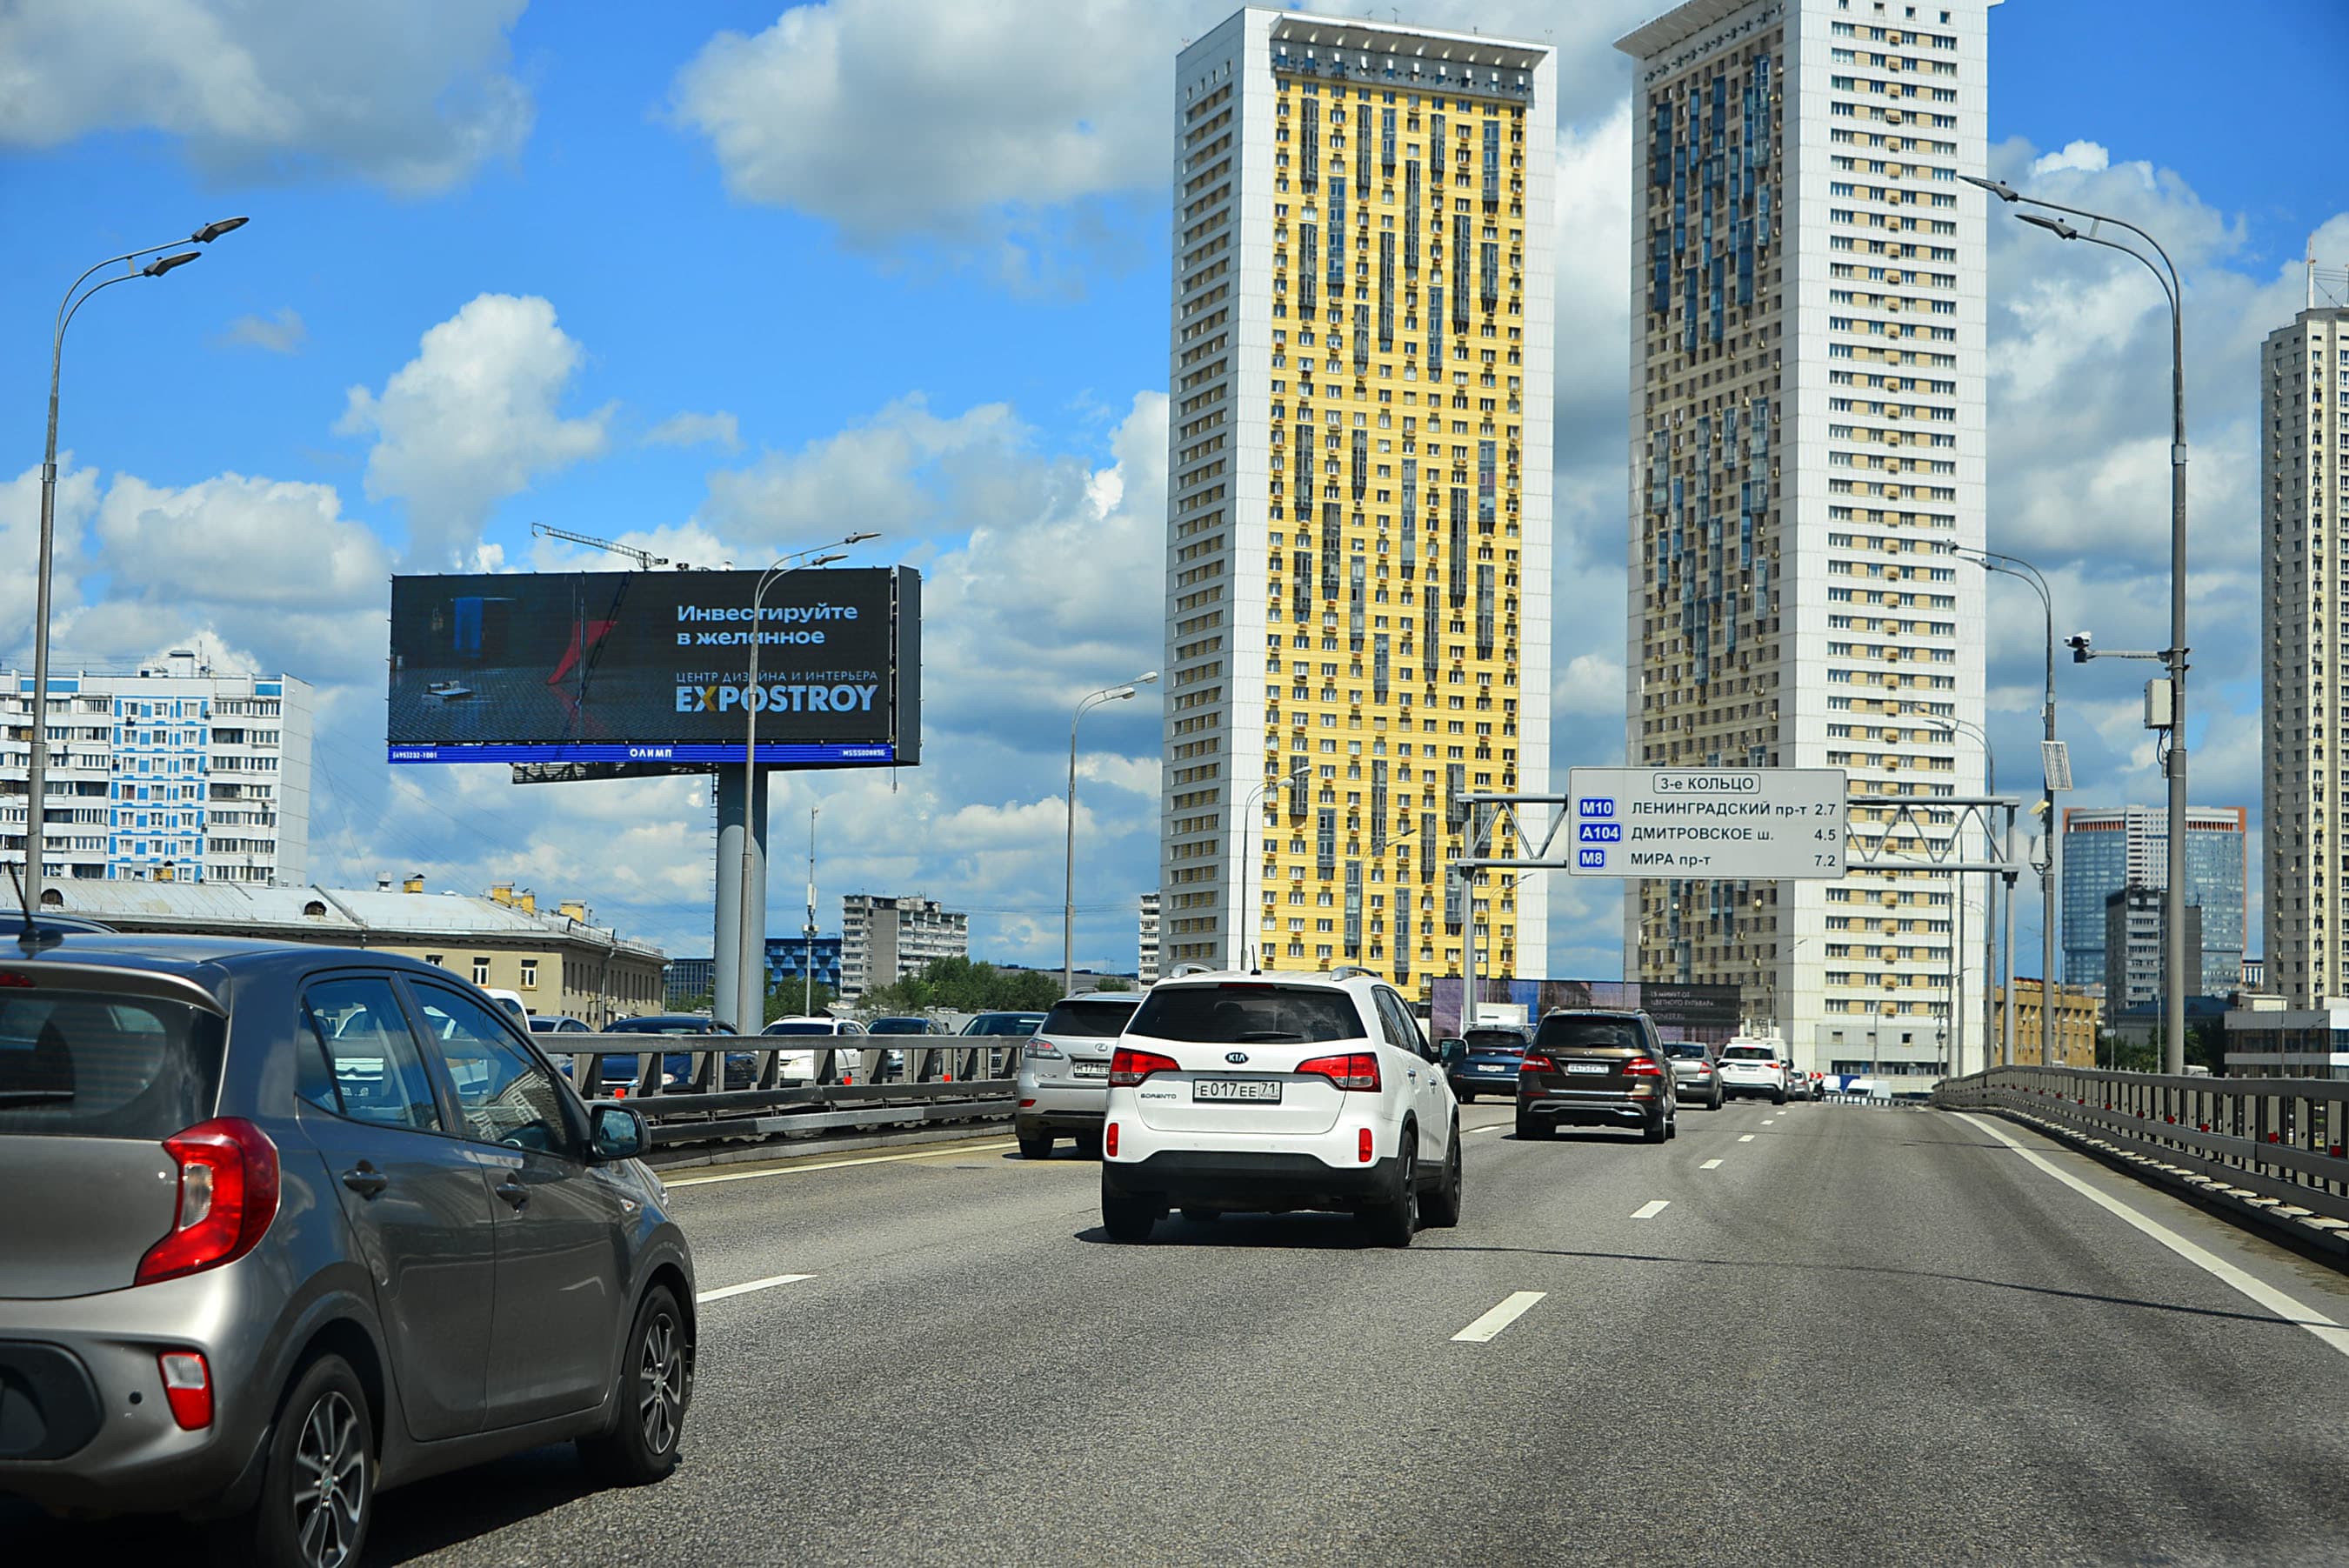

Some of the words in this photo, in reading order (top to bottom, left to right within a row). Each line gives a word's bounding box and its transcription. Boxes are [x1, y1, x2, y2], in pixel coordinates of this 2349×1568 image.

[677, 603, 858, 624] Инвестируйте
[677, 632, 691, 645] в
[696, 631, 825, 645] желанное
[676, 671, 718, 683] ЦЕНТР
[722, 670, 787, 682] ДИЗЙНА
[791, 671, 801, 682] И
[805, 671, 878, 682] ИНТЕРЬЕРА
[676, 684, 879, 712] EXPOSTROY
[629, 748, 672, 757] ОЛИМП
[1660, 777, 1683, 790] 3-е
[1687, 777, 1754, 792] КОЛЬЦО
[1582, 802, 1613, 814] М10
[1632, 800, 1771, 816] ЛЕНИНГРАДСКИЙ
[1775, 805, 1807, 817] пр-т
[1815, 804, 1836, 816] 2.7
[1581, 827, 1620, 839] А104
[1632, 827, 1752, 842] ДМИТРОВСКОЕ
[1757, 830, 1774, 841] ш.
[1814, 829, 1836, 841] 4.5
[1582, 853, 1604, 865] М8
[1631, 853, 1674, 865] МИРА
[1679, 856, 1712, 868] пр-т
[1814, 855, 1836, 867] 7.2
